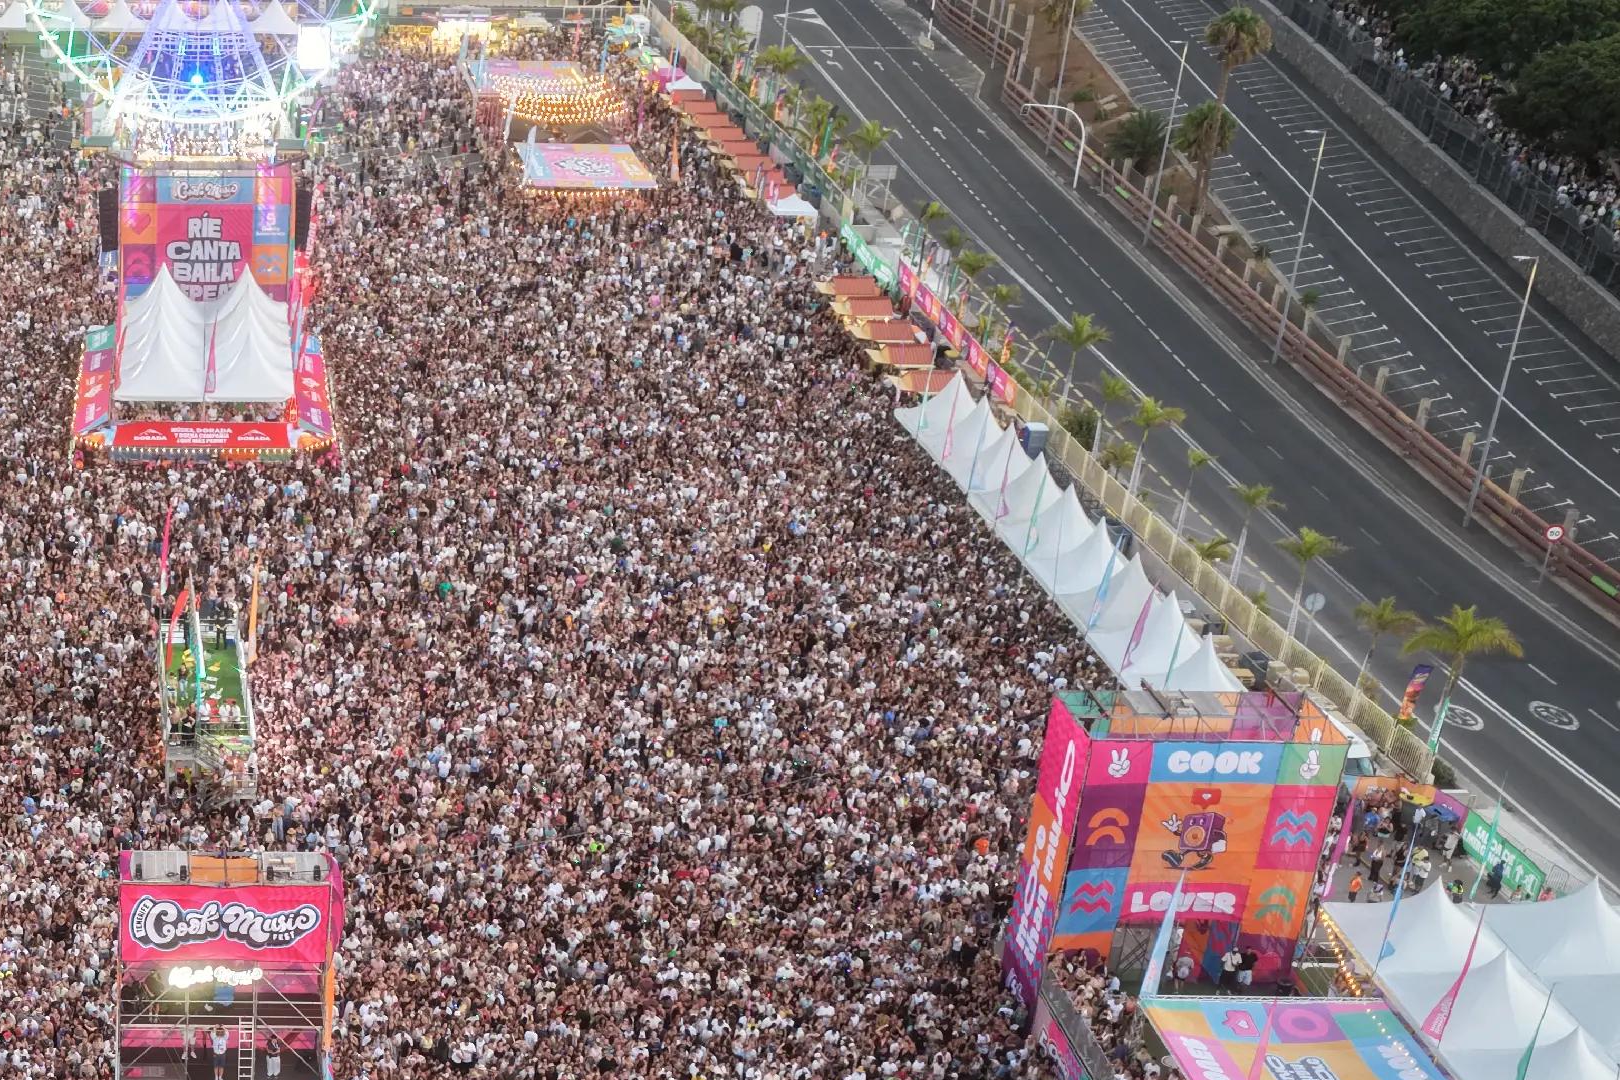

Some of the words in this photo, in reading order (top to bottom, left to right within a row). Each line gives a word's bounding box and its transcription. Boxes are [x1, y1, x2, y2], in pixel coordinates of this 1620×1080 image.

[188, 212, 222, 238] RÍE
[167, 240, 241, 260] CANTA
[173, 262, 234, 282] BAILA
[1168, 750, 1263, 775] COOK
